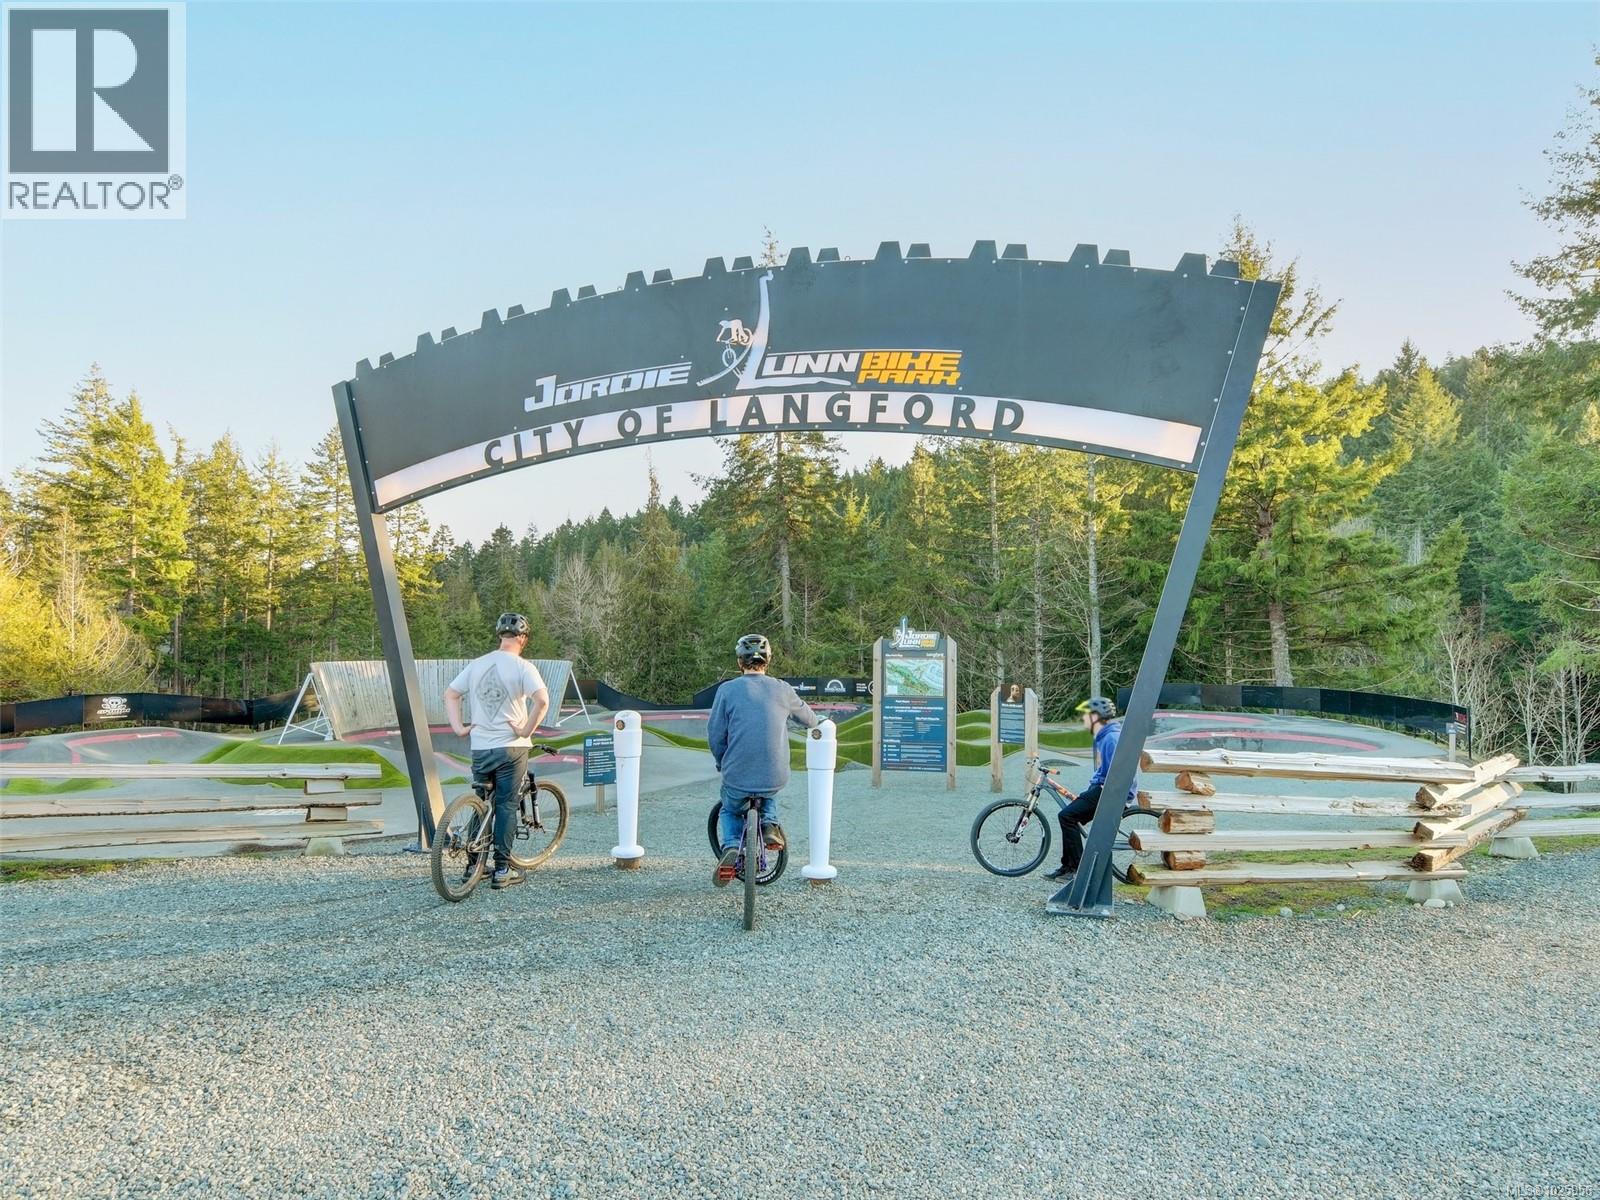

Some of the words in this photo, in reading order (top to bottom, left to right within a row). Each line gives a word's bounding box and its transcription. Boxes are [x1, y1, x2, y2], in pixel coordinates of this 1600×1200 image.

[524, 361, 692, 413] JORDIE
[862, 351, 963, 371] BIKE
[856, 369, 961, 386] PARK
[484, 419, 586, 467] CITY
[617, 405, 674, 439] OF
[709, 391, 1025, 433] LANGFORD
